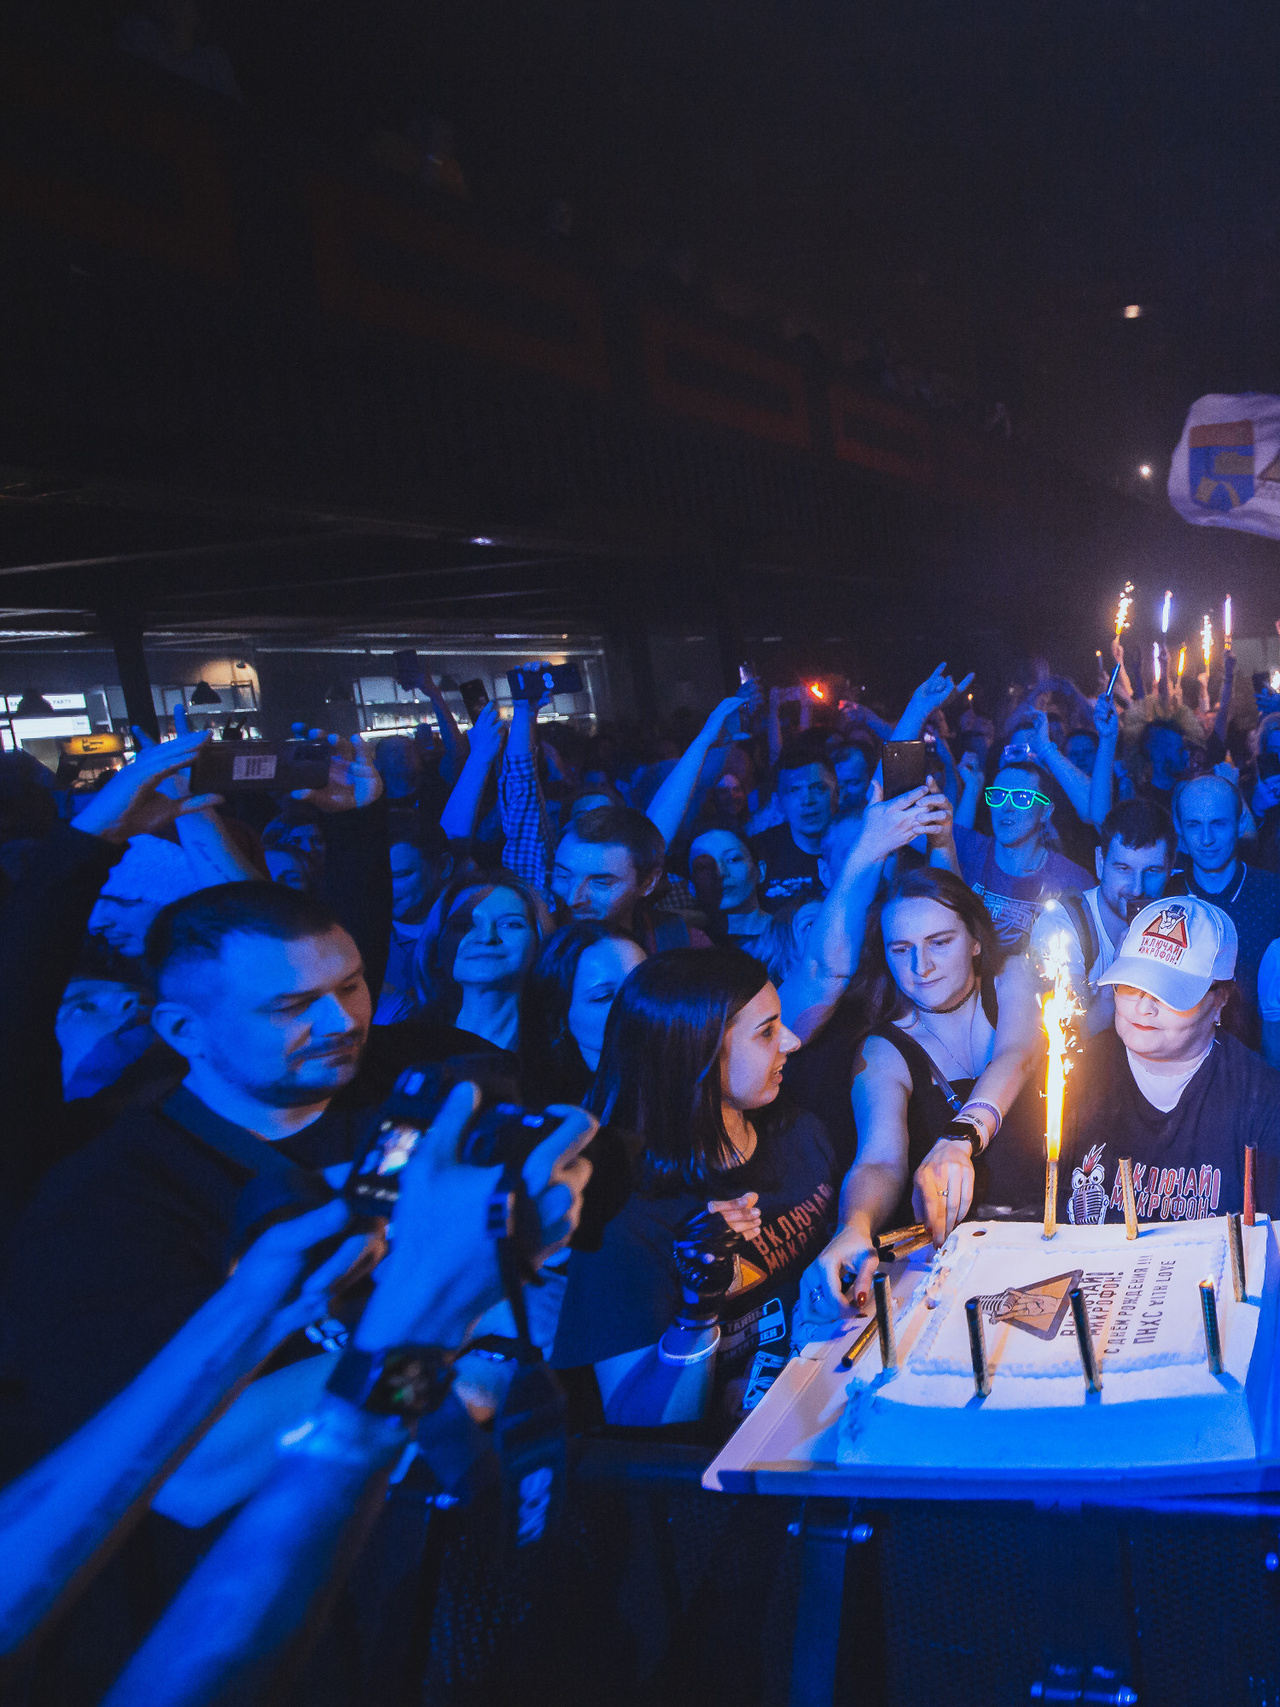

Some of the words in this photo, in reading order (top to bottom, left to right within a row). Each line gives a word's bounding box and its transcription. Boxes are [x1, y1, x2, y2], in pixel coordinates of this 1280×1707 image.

[1156, 1260, 1176, 1282] LOVE
[1117, 1267, 1149, 1316] РОЖДЕНИЯ
[1107, 1319, 1130, 1345] ДНЁМ
